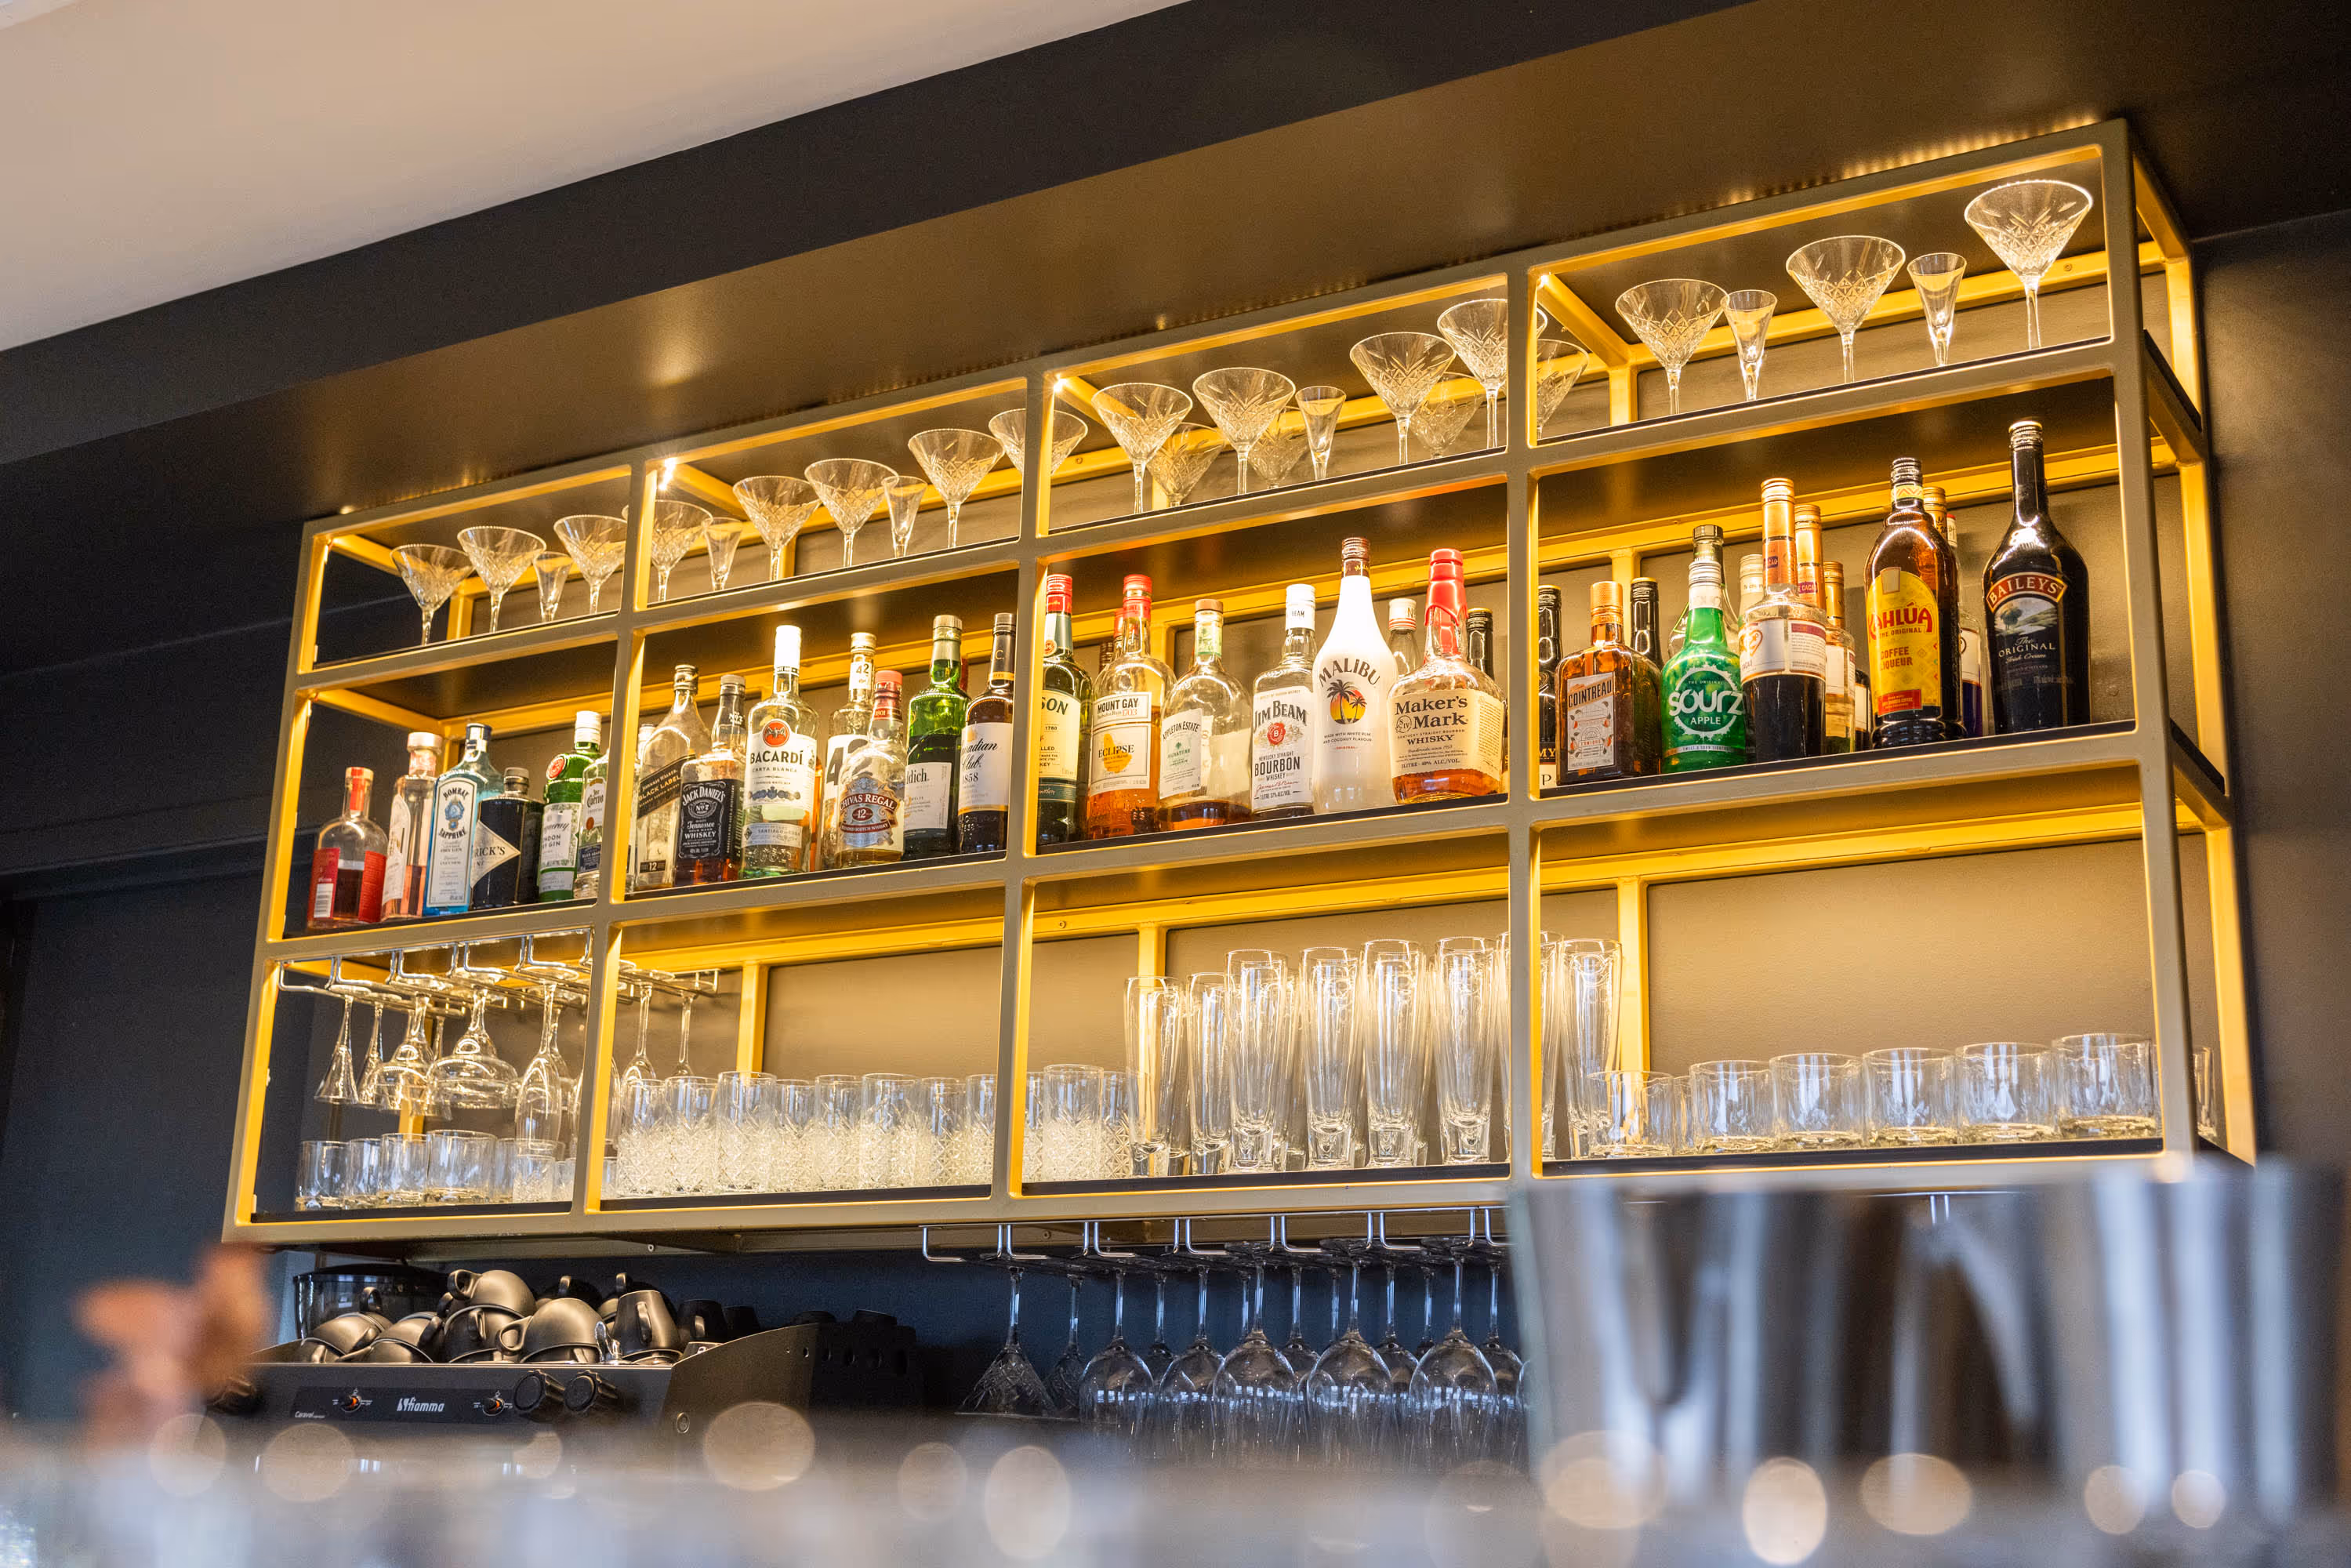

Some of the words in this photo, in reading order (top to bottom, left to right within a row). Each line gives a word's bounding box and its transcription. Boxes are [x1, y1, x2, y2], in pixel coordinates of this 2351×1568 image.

[1989, 576, 2058, 604] BAILEYS
[1868, 602, 1932, 640] KAHLÚA
[1891, 627, 1921, 637] ORIGINAL
[2015, 637, 2034, 646] The
[1881, 647, 1910, 659] COFFEE
[1999, 643, 2055, 658] ORIGINAL
[856, 664, 869, 674] 42
[1881, 657, 1913, 671] LIQUEUR
[1319, 658, 1380, 688] MALIBU
[1569, 680, 1612, 707] COINTREAU
[1042, 698, 1068, 715] SON
[1097, 699, 1120, 714] MOUNT
[1123, 698, 1138, 709] GAY
[1395, 696, 1468, 715] Maker's
[1254, 706, 1272, 734] JIM
[1273, 700, 1308, 726] BEAM
[1413, 712, 1468, 730] Mark
[1163, 724, 1181, 739] APPLETON
[1183, 720, 1201, 732] ESTATE
[1407, 734, 1455, 746] WHISKY
[750, 750, 803, 765] BACARDÍ
[1098, 745, 1135, 758] ECLIPSE
[1540, 749, 1556, 757] MY
[1255, 757, 1300, 776] BOURBON
[1266, 772, 1286, 782] WHISKEY
[443, 787, 470, 800] BOMBAY
[639, 786, 659, 801] BLACK
[660, 775, 681, 789] LABEL
[682, 789, 699, 806] JACK
[699, 786, 726, 803] DANIEL'S
[840, 794, 863, 811] CHIVAS
[865, 793, 894, 809] REGAL
[858, 808, 866, 818] 12
[687, 821, 715, 829] Tennessee
[439, 827, 466, 840] SAPPHIRE
[544, 833, 561, 842] NDON
[684, 831, 717, 840] WHISKEY
[474, 846, 506, 857] RICK'S
[649, 862, 657, 871] 12
